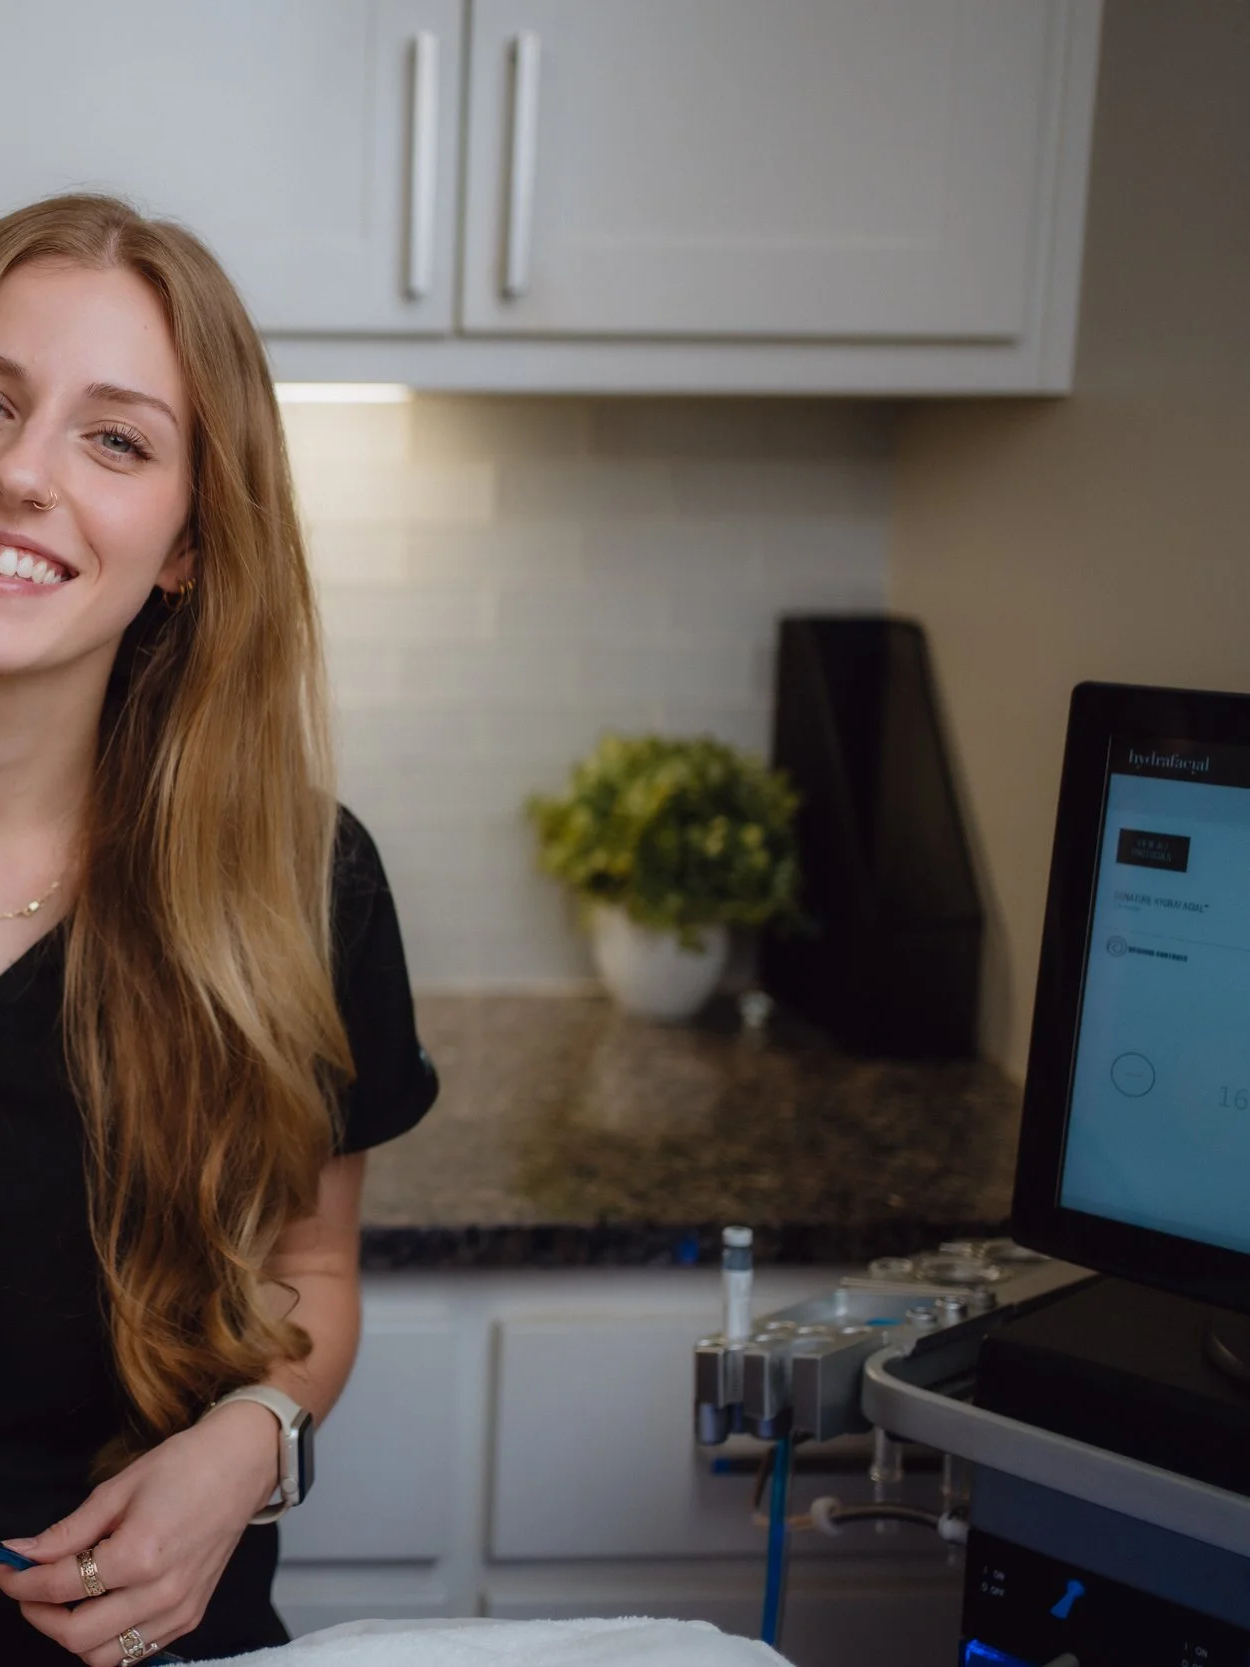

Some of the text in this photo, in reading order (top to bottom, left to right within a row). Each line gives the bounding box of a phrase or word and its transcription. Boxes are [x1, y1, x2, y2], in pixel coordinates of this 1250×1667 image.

[1128, 748, 1210, 775] hydrafacial
[1217, 1085, 1249, 1111] 16
[1195, 1646, 1208, 1658] ON
